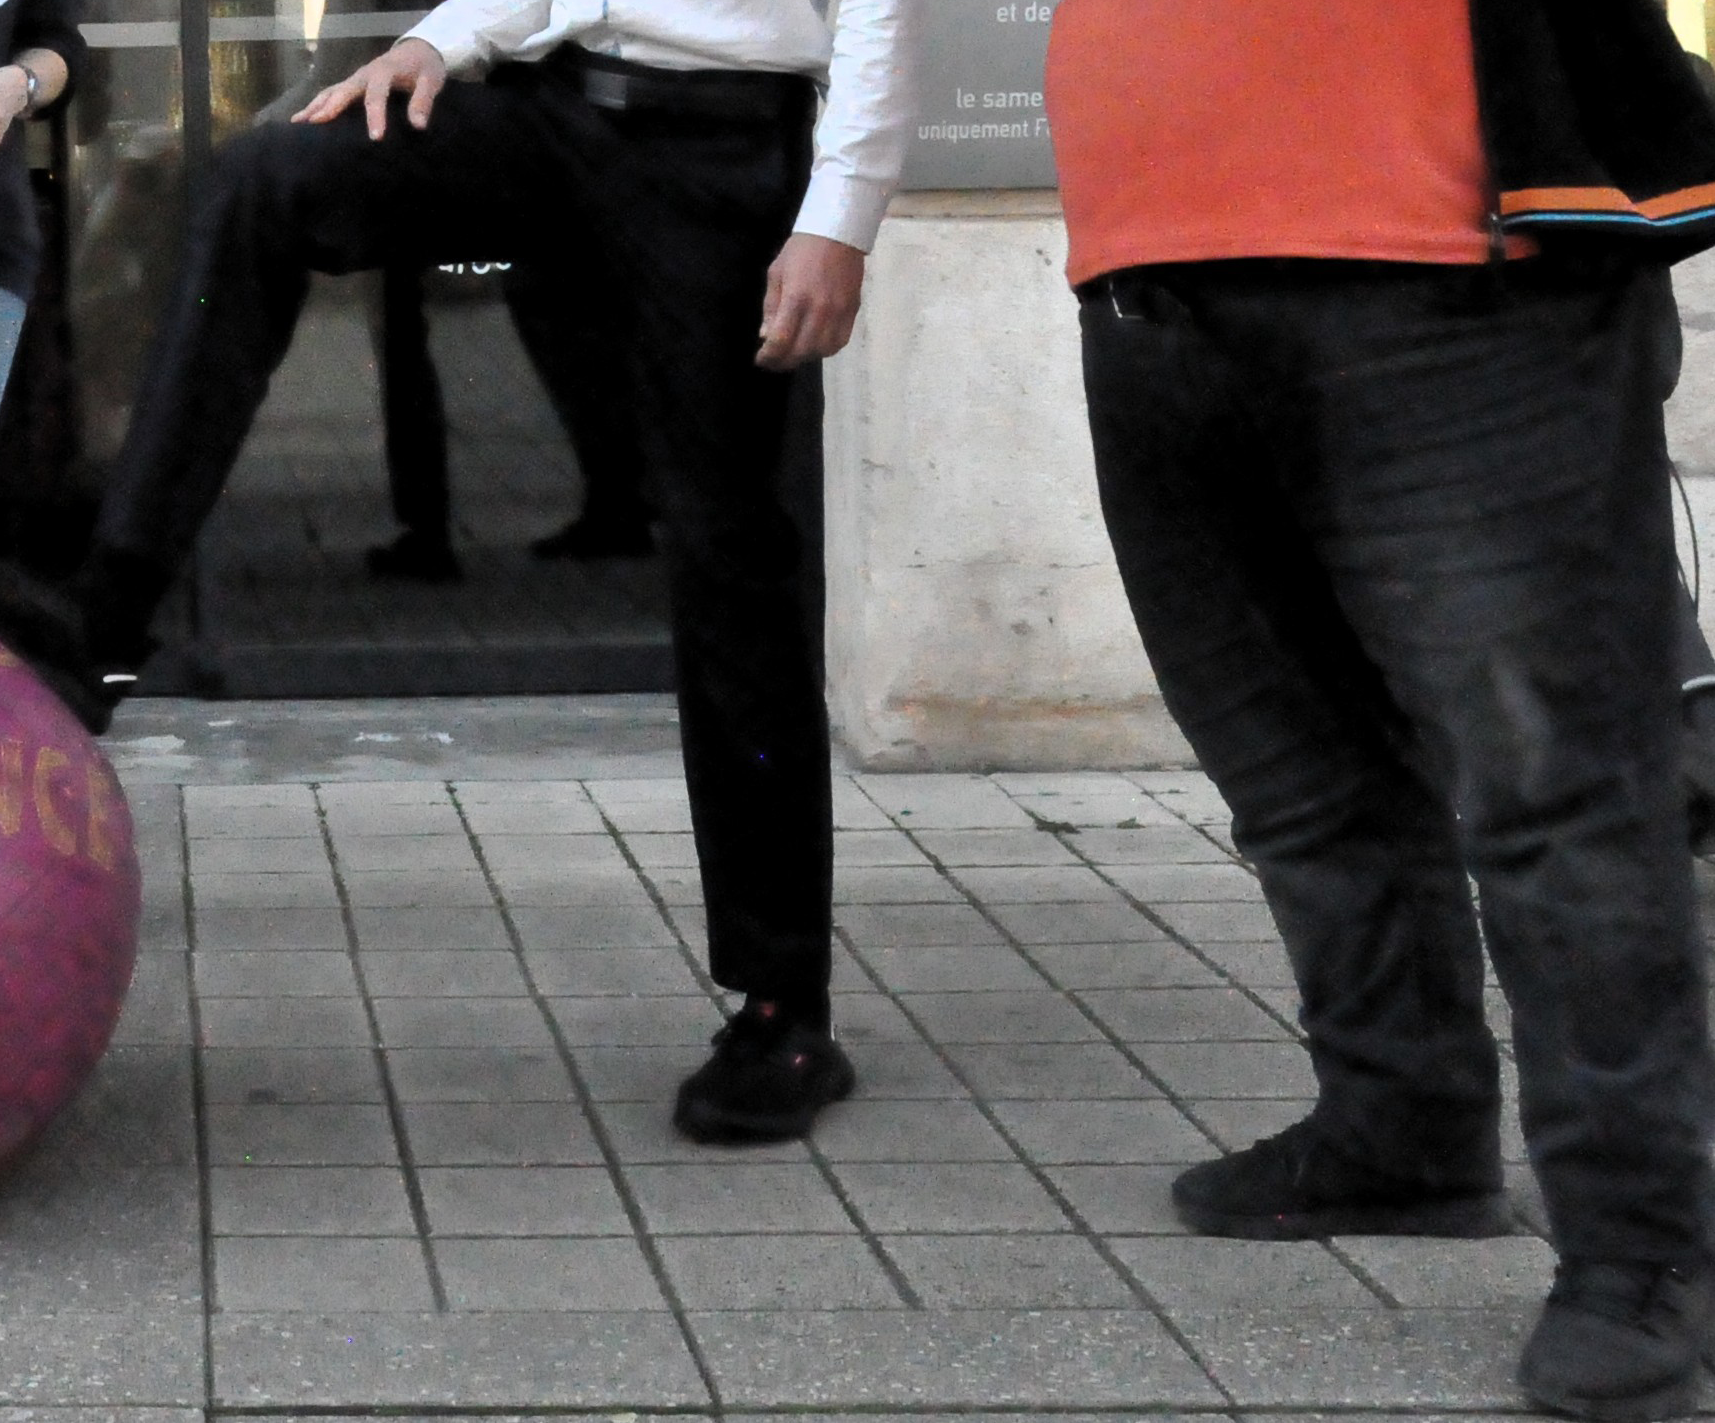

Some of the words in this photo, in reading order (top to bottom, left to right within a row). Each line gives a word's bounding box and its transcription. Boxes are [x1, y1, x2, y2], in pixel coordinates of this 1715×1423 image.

[996, 2, 1017, 22] et
[1024, 0, 1051, 22] de
[956, 87, 976, 109] le
[918, 120, 1029, 144] uniquement
